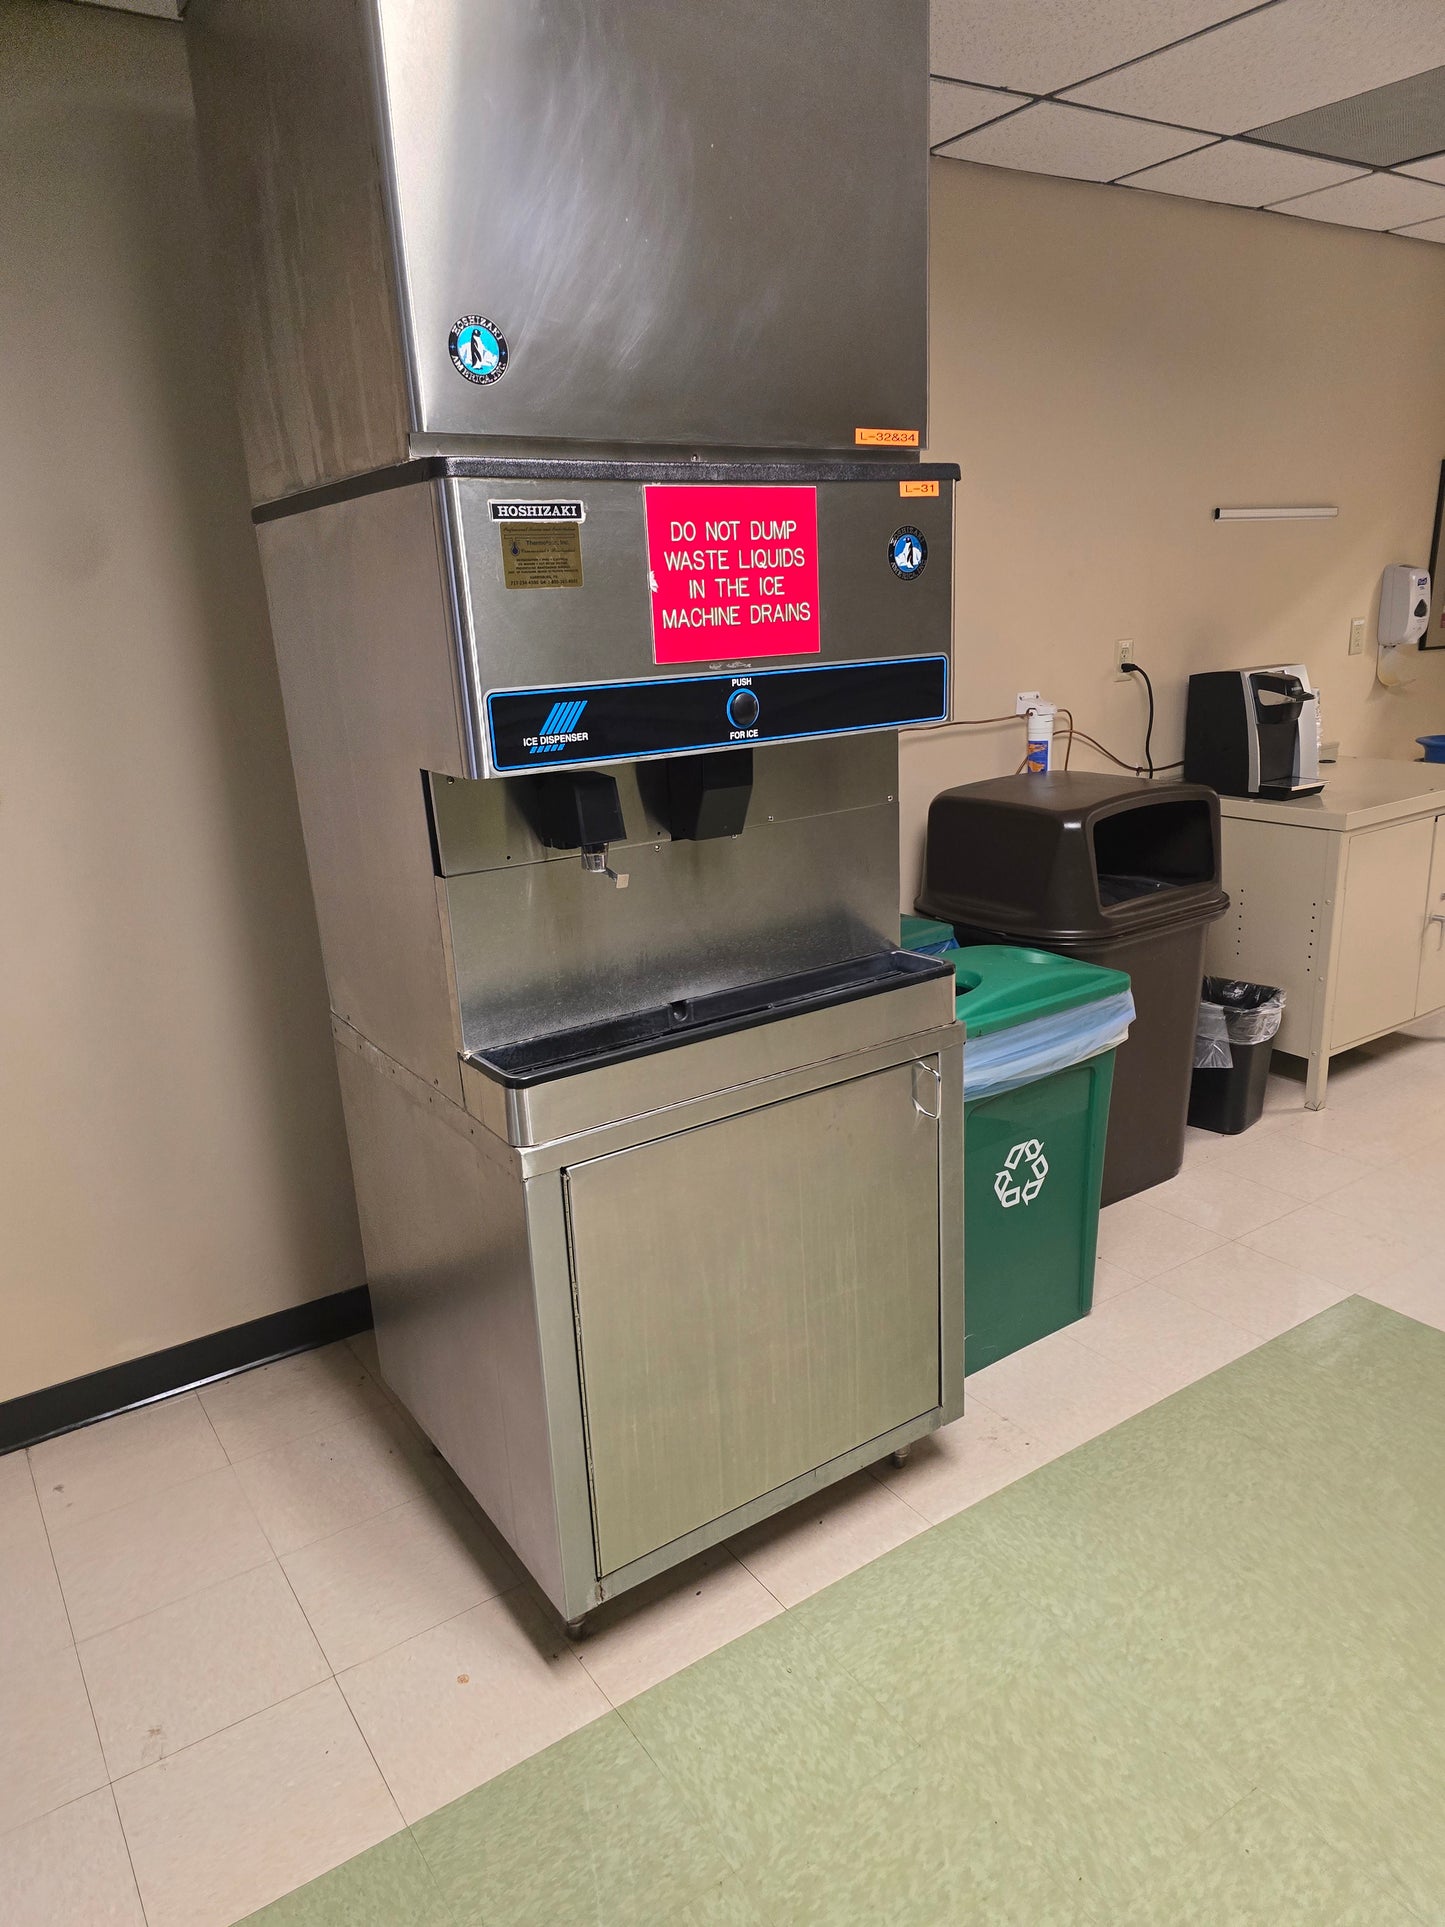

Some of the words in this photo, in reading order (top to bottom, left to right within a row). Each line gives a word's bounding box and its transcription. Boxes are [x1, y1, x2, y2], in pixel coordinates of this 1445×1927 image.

[452, 316, 503, 341] HOSHIZAKI
[860, 431, 916, 442] L-32&34
[905, 484, 935, 493] L-31
[497, 505, 577, 517] HOSHIZAKI
[670, 521, 697, 542] DO
[705, 520, 740, 541] NOT
[750, 520, 797, 541] DUMP
[664, 549, 730, 571] WASTE
[738, 547, 805, 569] LIQUIDS
[689, 579, 706, 599] IN
[714, 577, 750, 598] THE
[759, 576, 786, 596] ICE
[662, 605, 742, 629] MACHINE
[750, 602, 811, 624] DRAINS
[731, 677, 752, 687] PUSH
[523, 736, 539, 747] ICE
[539, 732, 589, 746] DISPENSER
[730, 730, 746, 740] FOR
[746, 729, 759, 738] ICE
